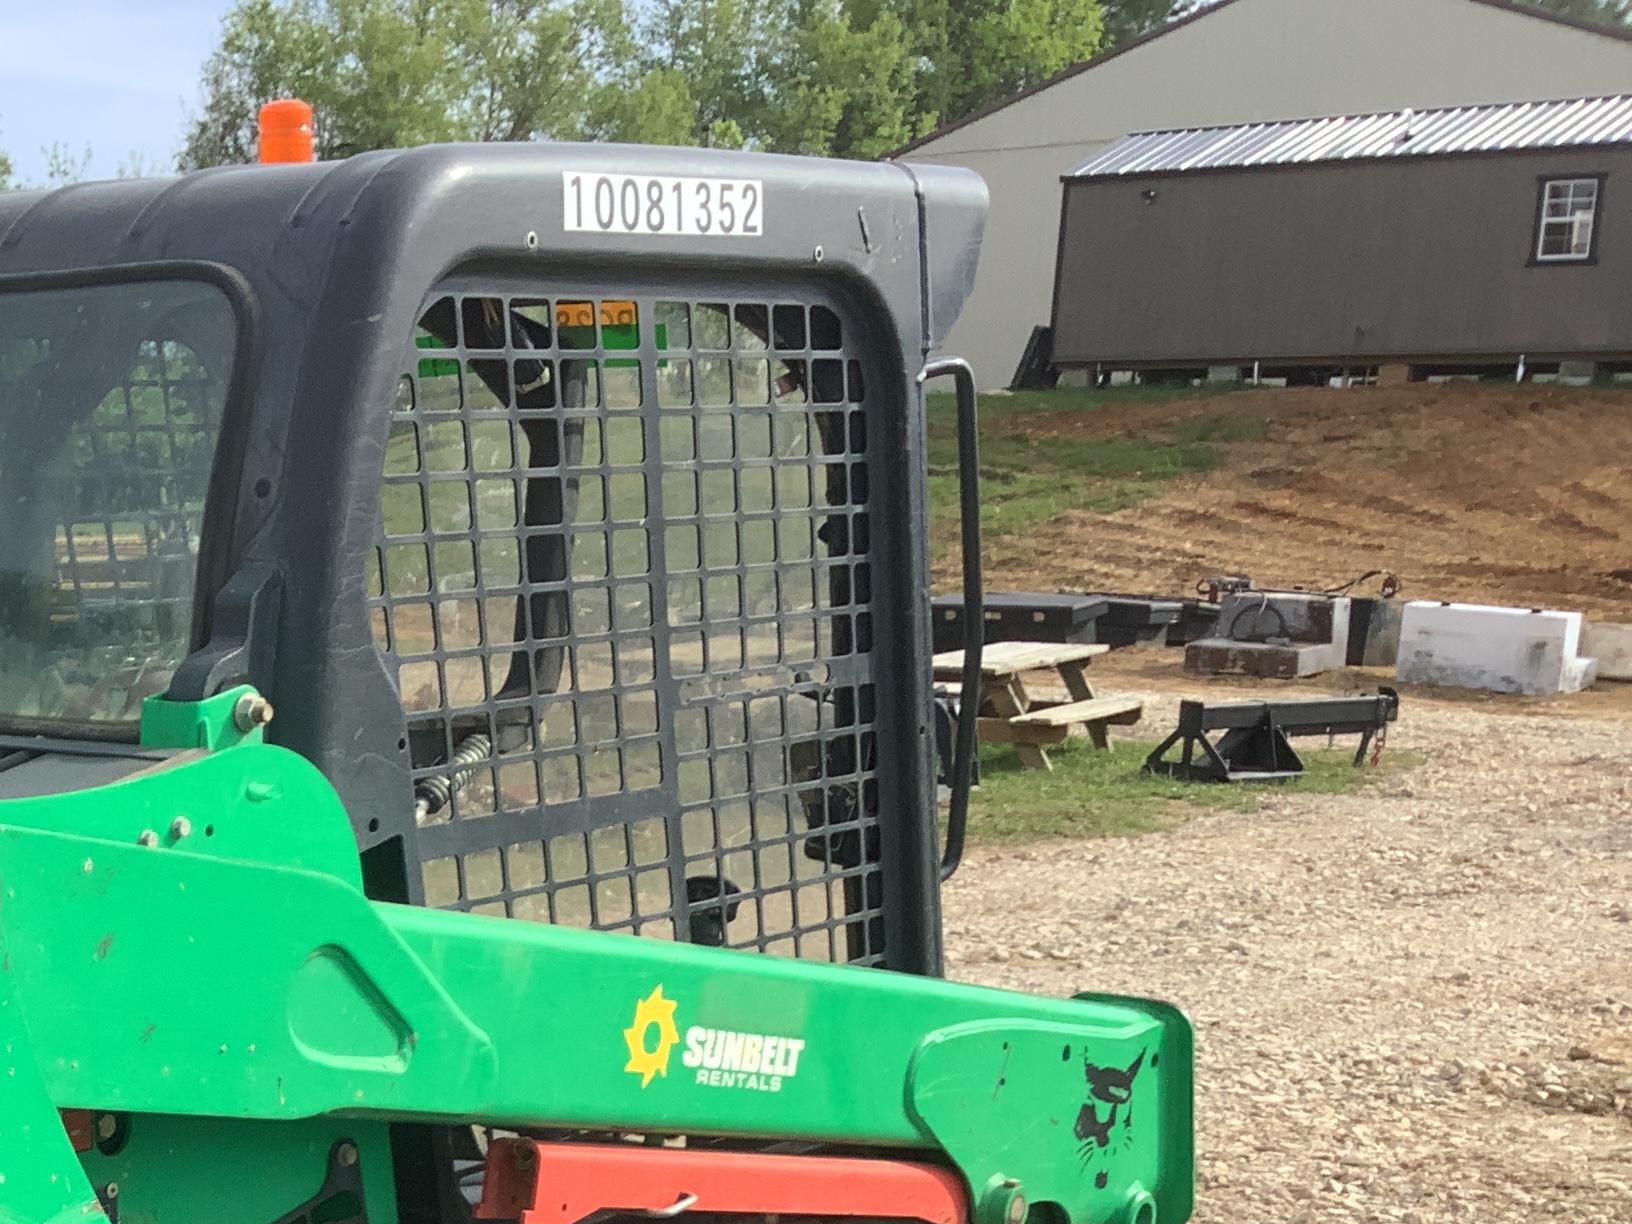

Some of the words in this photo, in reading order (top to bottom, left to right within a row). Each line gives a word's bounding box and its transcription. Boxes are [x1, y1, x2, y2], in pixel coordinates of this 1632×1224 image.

[570, 175, 758, 234] 10081352
[682, 1025, 806, 1077] SUNBELT
[695, 1069, 782, 1092] RENTALS
